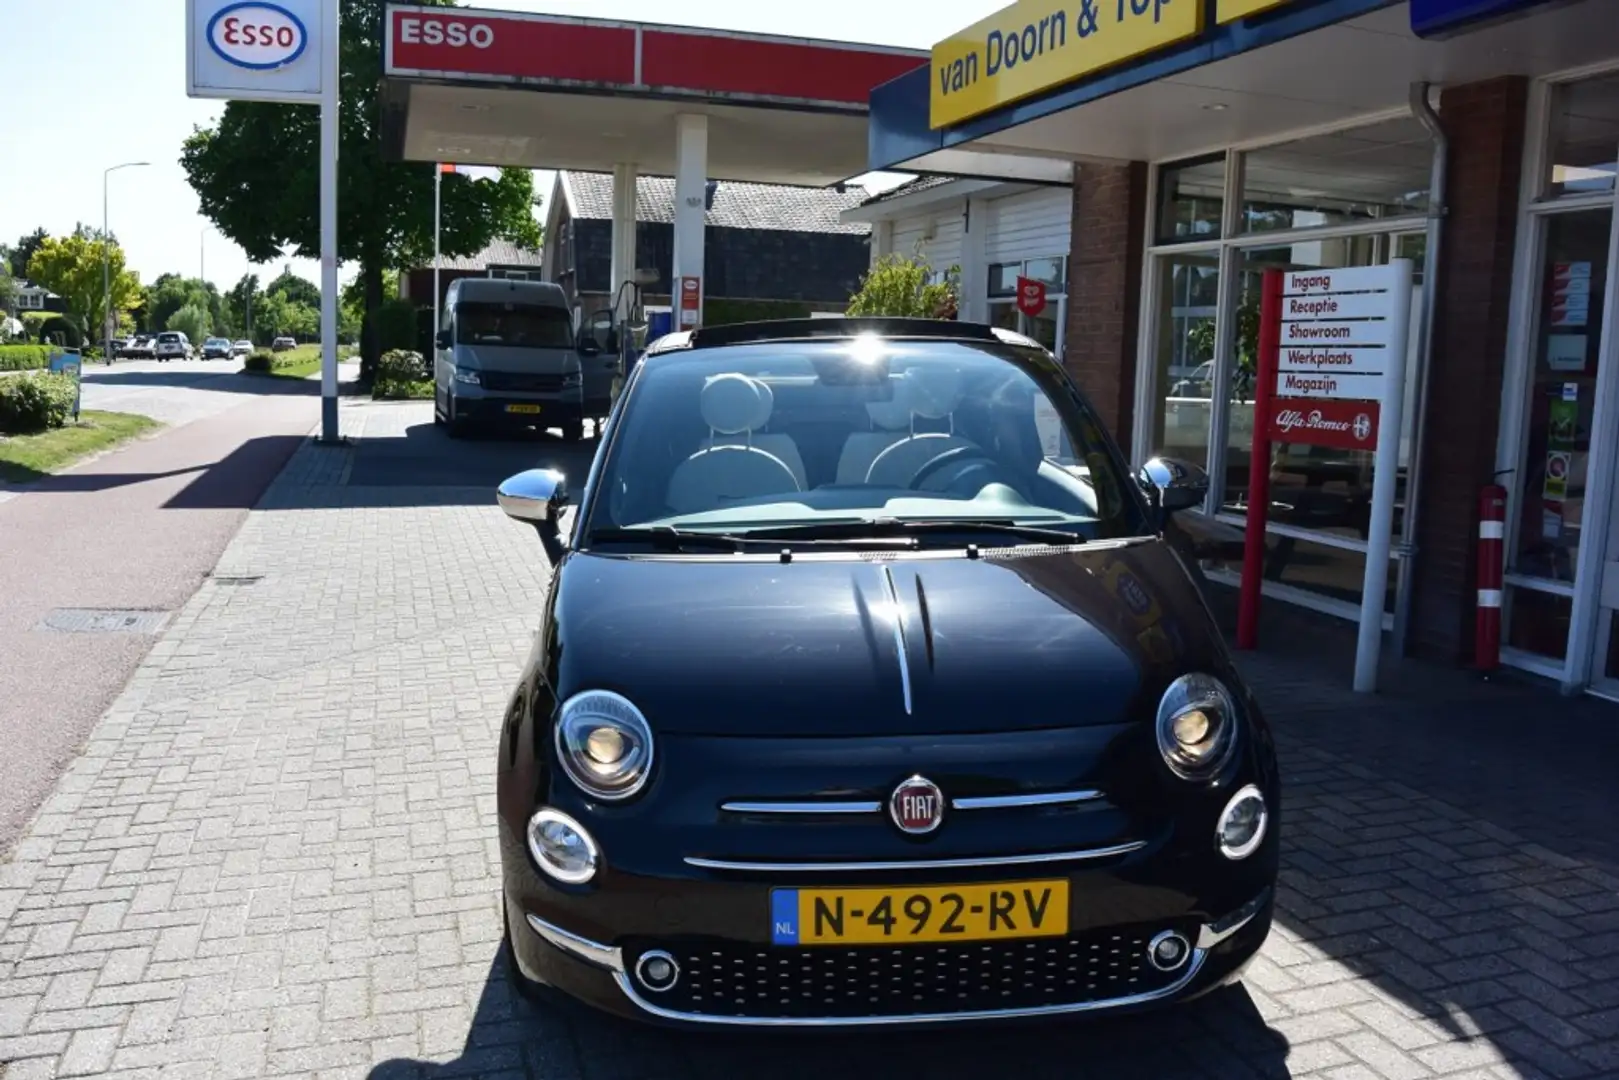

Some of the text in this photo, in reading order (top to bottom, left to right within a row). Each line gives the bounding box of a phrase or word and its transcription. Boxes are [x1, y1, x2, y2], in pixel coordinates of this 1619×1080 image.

[223, 17, 294, 47] Esso
[401, 18, 494, 48] ESSO
[940, 51, 978, 96] van
[986, 9, 1066, 77] Doorn
[1077, 0, 1098, 38] &
[1291, 274, 1331, 291] Ingang
[1290, 297, 1338, 316] Receptie
[1288, 324, 1351, 339] Showroom
[1288, 350, 1353, 368] Werkplaats
[1285, 375, 1337, 394] Magazijn
[1276, 409, 1350, 433] Alfa Romeo
[902, 795, 935, 820] FIAT
[775, 887, 1052, 937] NL N-492-RV
